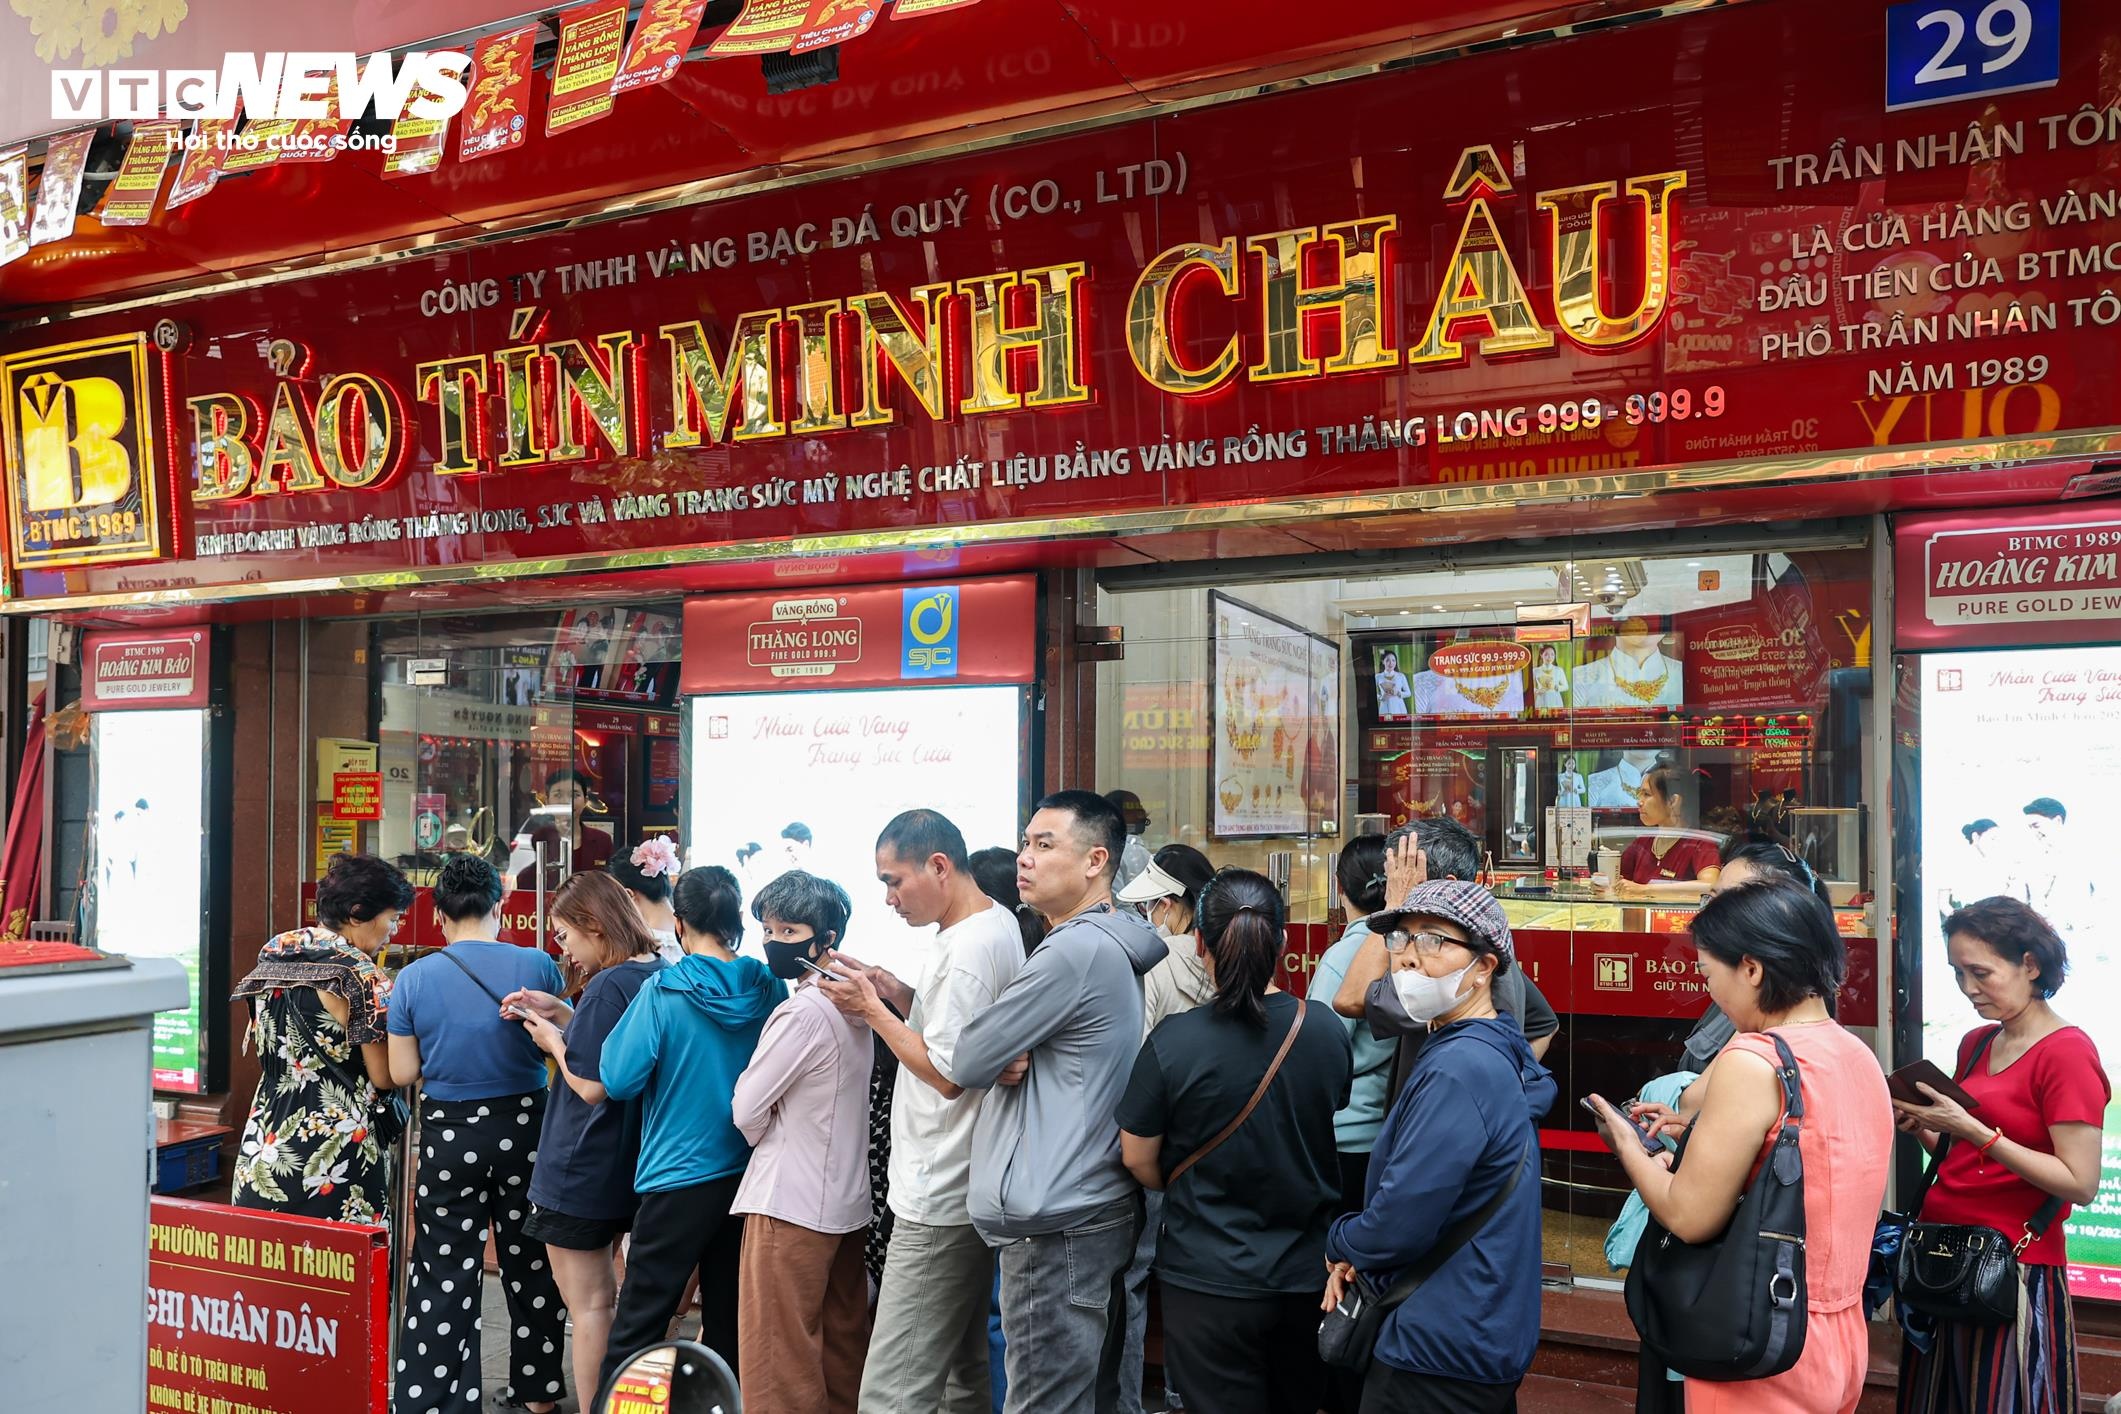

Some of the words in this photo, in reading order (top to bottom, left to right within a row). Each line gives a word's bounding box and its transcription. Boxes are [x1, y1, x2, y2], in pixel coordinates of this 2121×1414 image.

[565, 38, 593, 55] VÀNG
[593, 28, 620, 46] RỒNG
[594, 42, 619, 57] LONG
[1914, 0, 2034, 86] 29
[1768, 136, 1884, 190] TRẦN
[1896, 119, 2025, 172] NHÂN
[420, 278, 501, 317] CÔNG
[508, 269, 547, 303] TY
[555, 254, 636, 294] TNHH
[647, 238, 737, 279] VÀNG
[747, 222, 818, 266] BẠC
[830, 203, 881, 249] ĐÁ
[890, 187, 970, 237] QUÝ
[1096, 151, 1188, 204] LTD)
[1792, 224, 1834, 260] LÀ
[1842, 211, 1911, 252] CỬA
[1922, 203, 2032, 242] HÀNG
[1757, 272, 1828, 313] ĐẦU
[1841, 266, 1919, 303] TIÊN
[1928, 251, 2005, 293] CỦA
[186, 337, 392, 502] BẢO
[416, 305, 634, 477] TÍN
[659, 260, 1089, 450] MINH
[1124, 143, 1688, 394] CHÂU
[1839, 310, 1938, 353] TRẦN
[1947, 300, 2057, 339] NHÂN
[1867, 360, 1955, 397] NĂM
[1965, 353, 2050, 388] 1989
[235, 527, 296, 553] DOANH
[298, 520, 346, 547] VÀNG
[403, 509, 469, 539] THĂNG
[538, 502, 574, 528] SJC
[578, 494, 606, 525] VÀ
[612, 490, 671, 521] VÀNG
[674, 486, 749, 515] TRANG
[752, 476, 798, 509] SỨC
[803, 471, 840, 505] MỸ
[845, 463, 912, 502] NGHỆ
[918, 454, 985, 493] CHẤT
[991, 452, 1047, 490] LIỆU
[1055, 440, 1132, 481] BẰNG
[1139, 433, 1217, 473] VÀNG
[1224, 423, 1307, 465] RỒNG
[1316, 414, 1426, 455] THĂNG
[1436, 407, 1529, 445] LONG
[29, 517, 82, 542] BTMC
[89, 511, 136, 537] 1989
[2008, 533, 2068, 552] BTMC
[1935, 551, 2050, 590] HOÀNG
[2053, 552, 2117, 583] KIM
[776, 604, 804, 617] VÀNG
[805, 600, 834, 615] RỒNG
[1958, 600, 2009, 617] PURE
[2016, 597, 2074, 613] GOLD
[125, 647, 146, 657] BTMC
[147, 645, 165, 656] 1989
[751, 628, 808, 650] THĂNG
[811, 629, 858, 647] LONG
[99, 656, 140, 679] HOÀNG
[140, 659, 163, 675] KIM
[164, 651, 190, 674] BẢO
[791, 648, 812, 660] GOLD
[814, 648, 837, 659] 999.9
[1434, 654, 1462, 667] TRANG
[1463, 652, 1480, 664] SỨC
[106, 685, 125, 694] PURE
[126, 683, 147, 693] GOLD
[148, 681, 181, 692] JEWELRY
[1645, 956, 1687, 974] BẢO
[1653, 978, 1678, 992] GIỮ
[1680, 978, 1699, 992] TÍN
[149, 1223, 219, 1260] PHƯỜNG
[224, 1234, 255, 1266] HAI
[261, 1238, 286, 1272] BÀ
[190, 1290, 270, 1345] NHÂN
[275, 1302, 339, 1358] DÂN
[204, 1358, 229, 1383] TRÊN
[149, 1384, 182, 1410] KHÔNG
